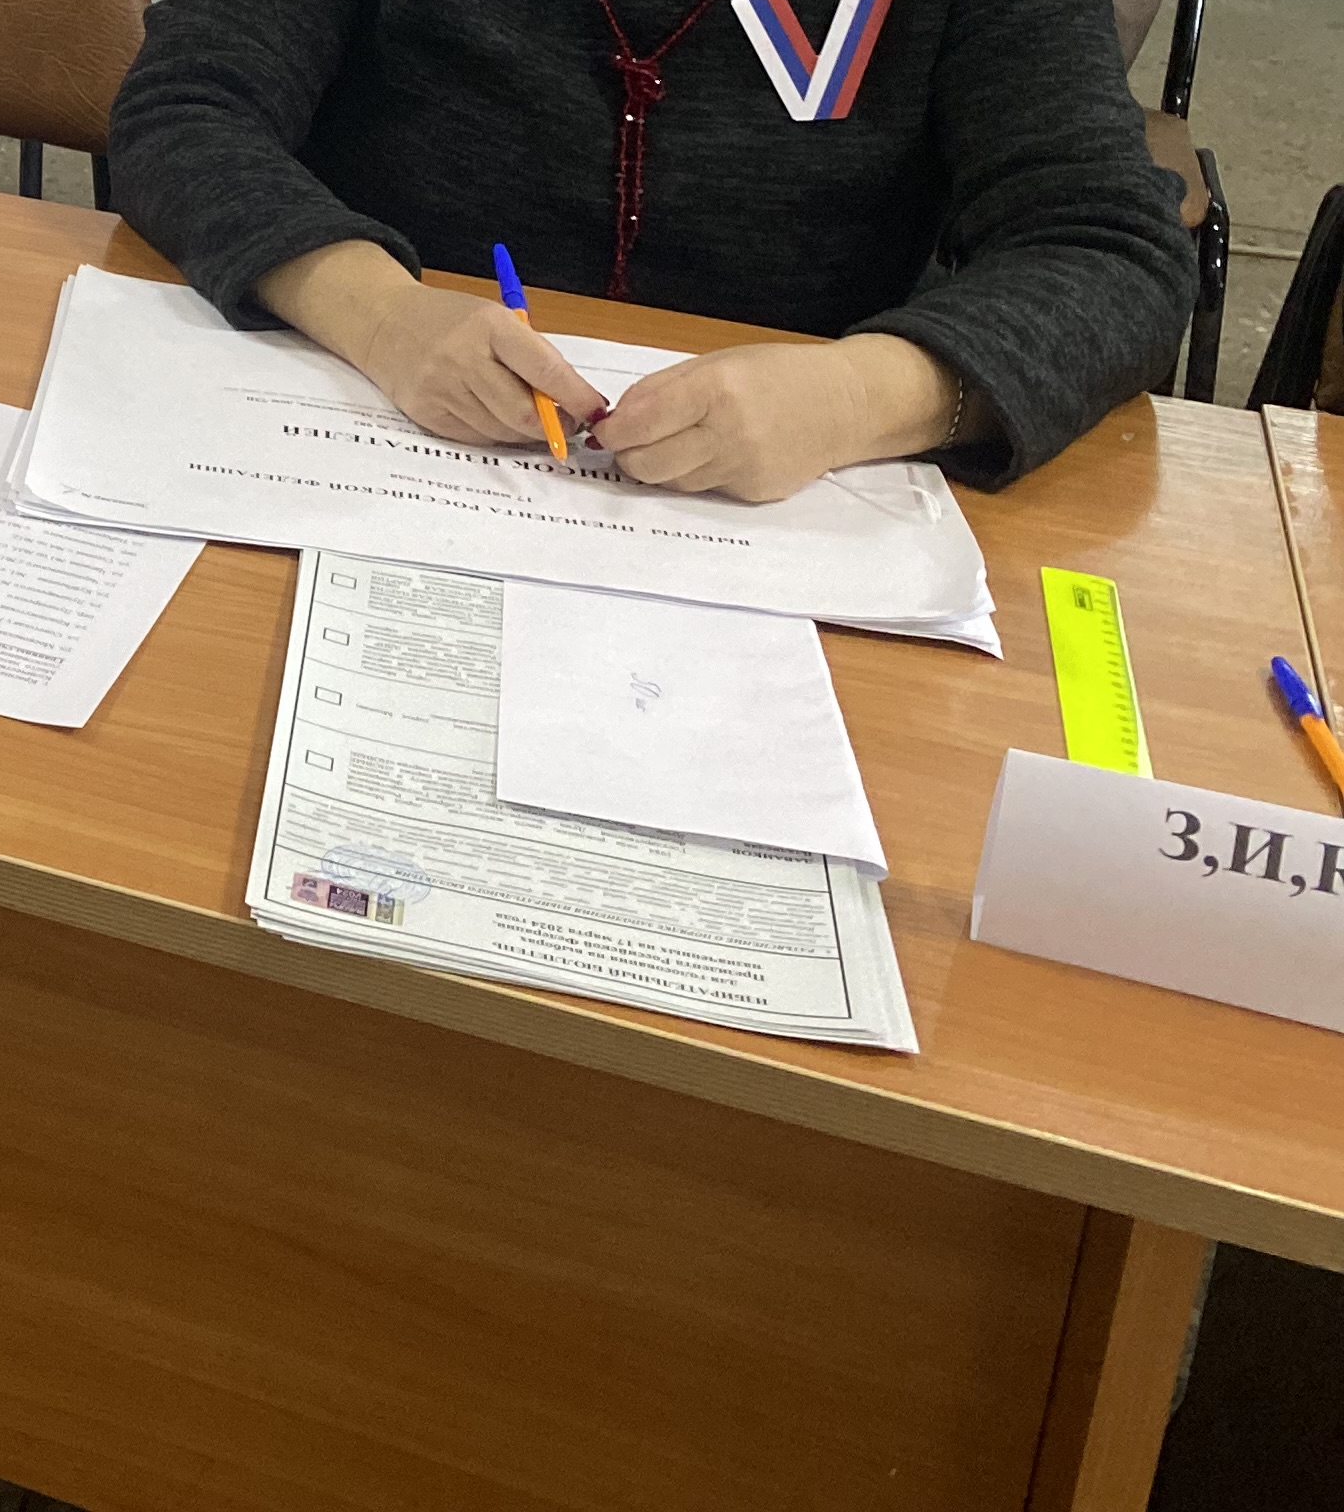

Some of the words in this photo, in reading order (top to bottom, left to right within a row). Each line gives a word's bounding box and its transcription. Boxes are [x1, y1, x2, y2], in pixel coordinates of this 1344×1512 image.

[283, 424, 500, 467] ИЗБИРАТЕЛЕЙ
[189, 462, 321, 487] ФЕДЕРАЦИИ
[511, 459, 641, 485] ПИСОК
[328, 482, 480, 512] РОССИЙСКОЙ
[485, 505, 636, 533] ПРЕЗИДЕНТА
[650, 528, 751, 547] ВЫБОРЫ
[491, 941, 604, 973] БЮЛЛЕТЕНЬ
[608, 967, 768, 1006] ИЗБИРАТЕЛЬНЫЙ
